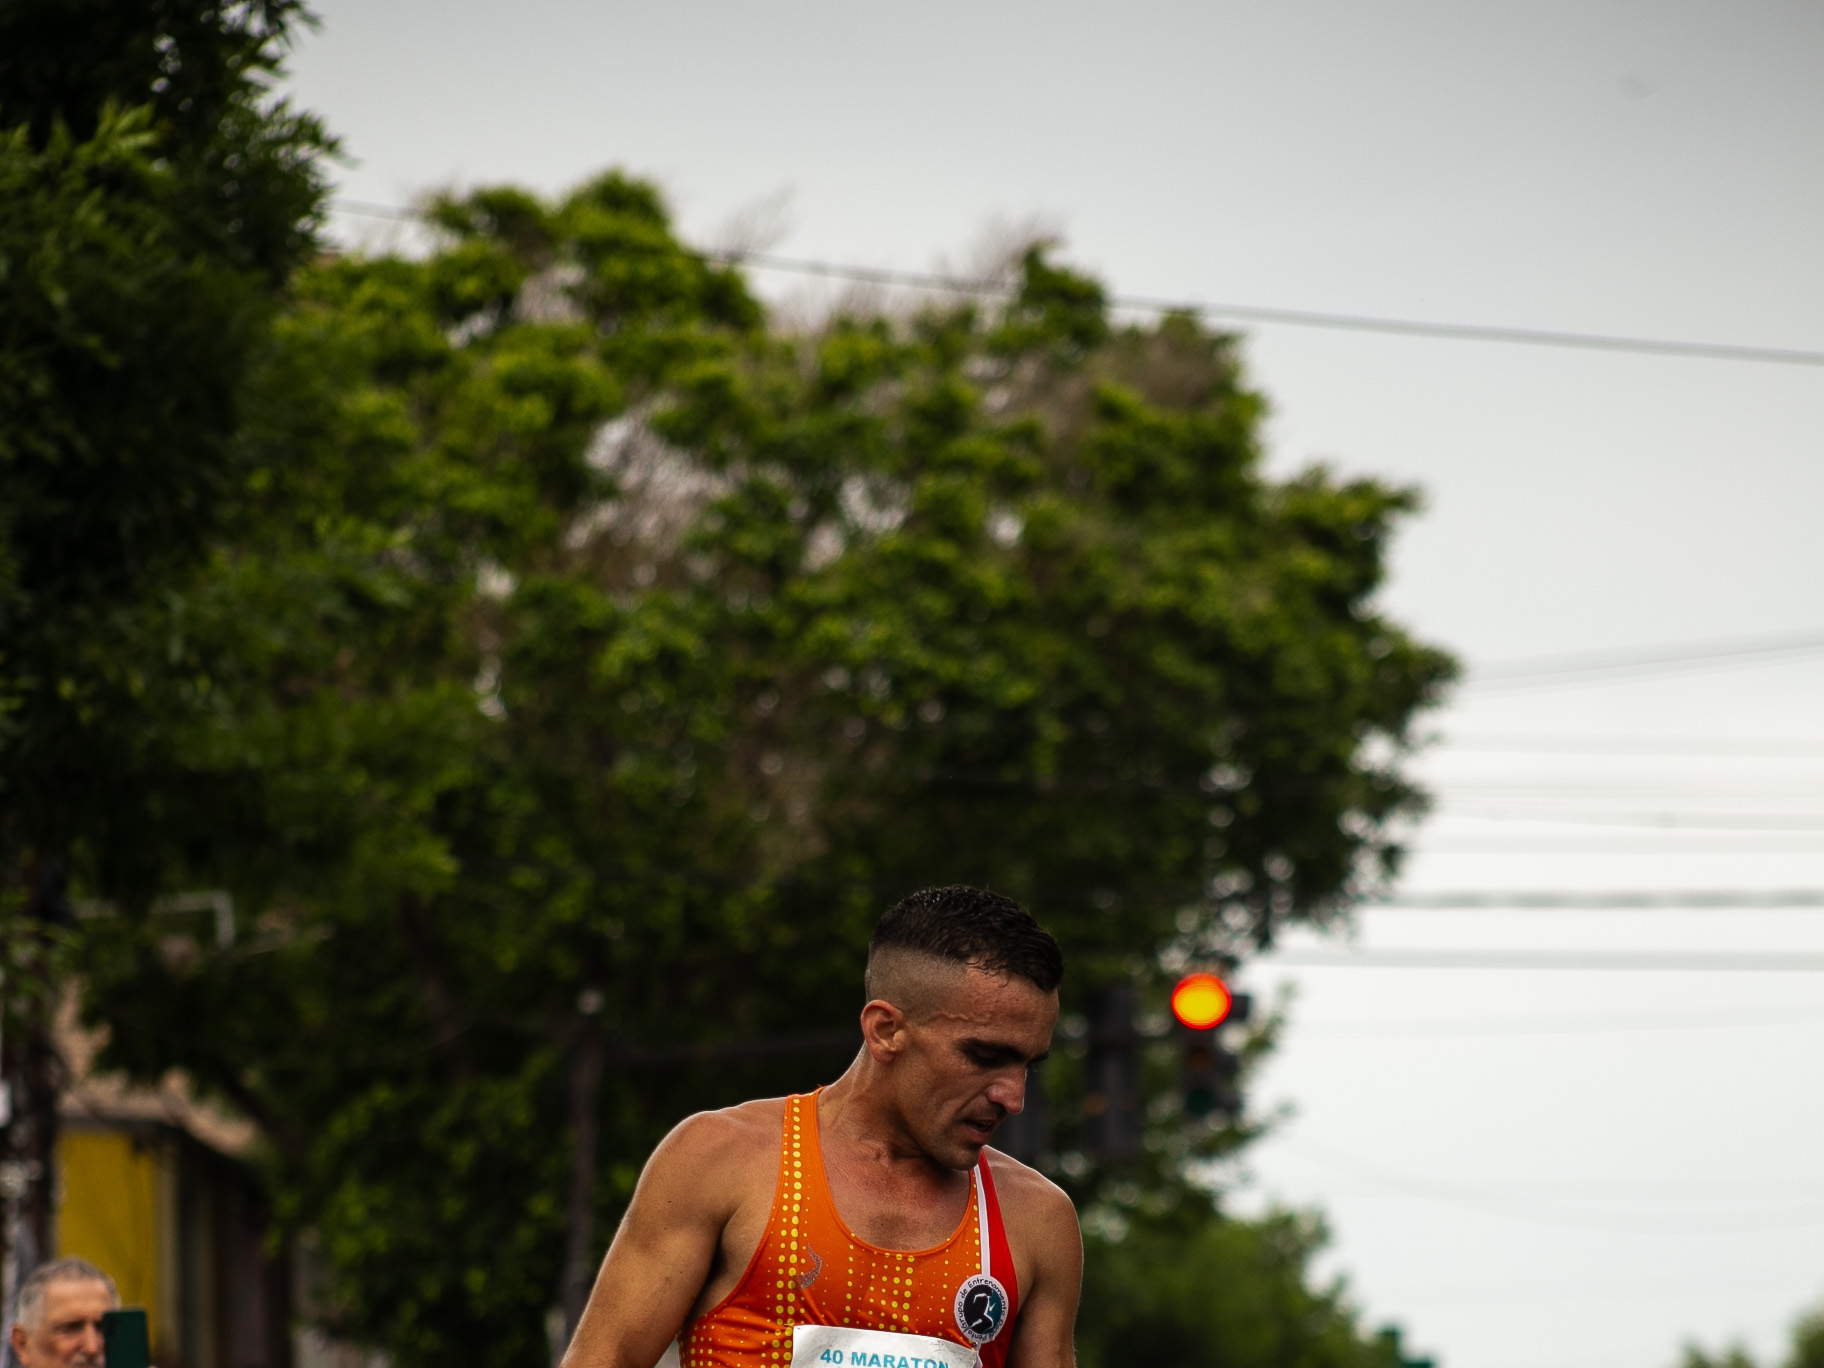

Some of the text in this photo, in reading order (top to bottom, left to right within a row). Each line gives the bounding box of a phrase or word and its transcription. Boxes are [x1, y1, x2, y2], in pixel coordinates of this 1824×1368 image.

[960, 1288, 968, 1299] de
[958, 1301, 969, 1328] Grupo
[820, 1349, 844, 1365] 40
